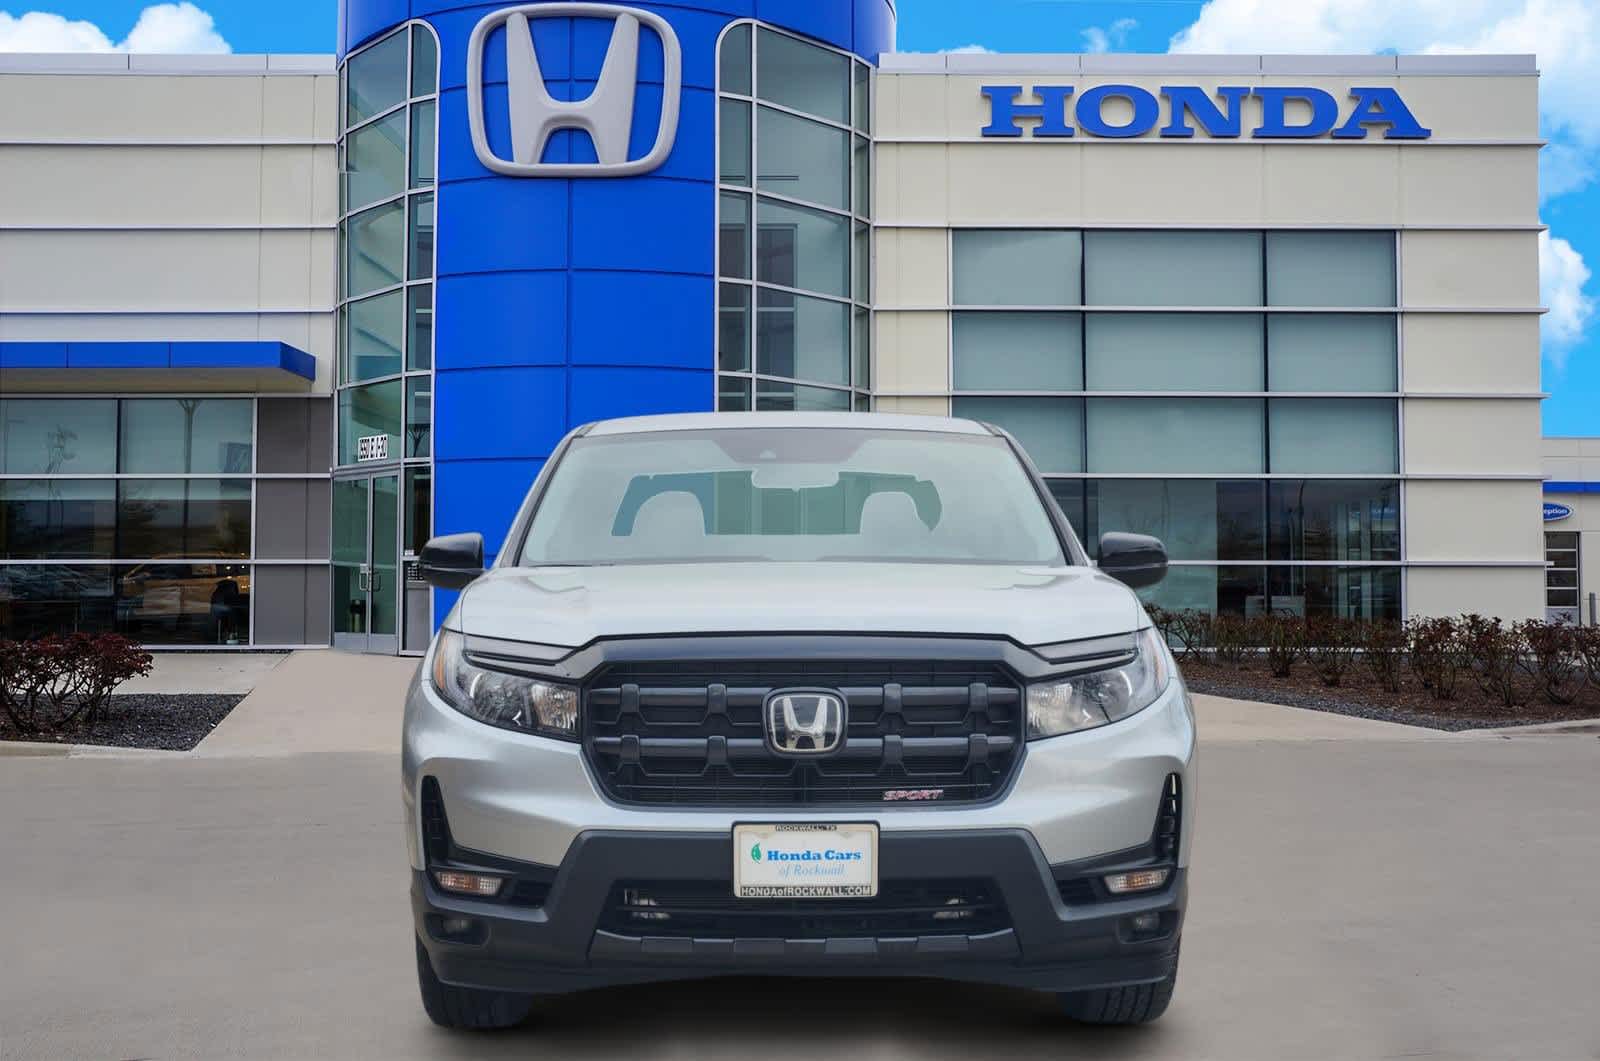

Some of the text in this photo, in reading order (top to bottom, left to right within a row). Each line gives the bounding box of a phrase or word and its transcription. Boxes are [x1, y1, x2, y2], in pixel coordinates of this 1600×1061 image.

[980, 84, 1432, 140] HONDA
[883, 789, 944, 801] SPORT
[767, 849, 862, 861] Honda Cars
[779, 863, 845, 877] of Rockwall
